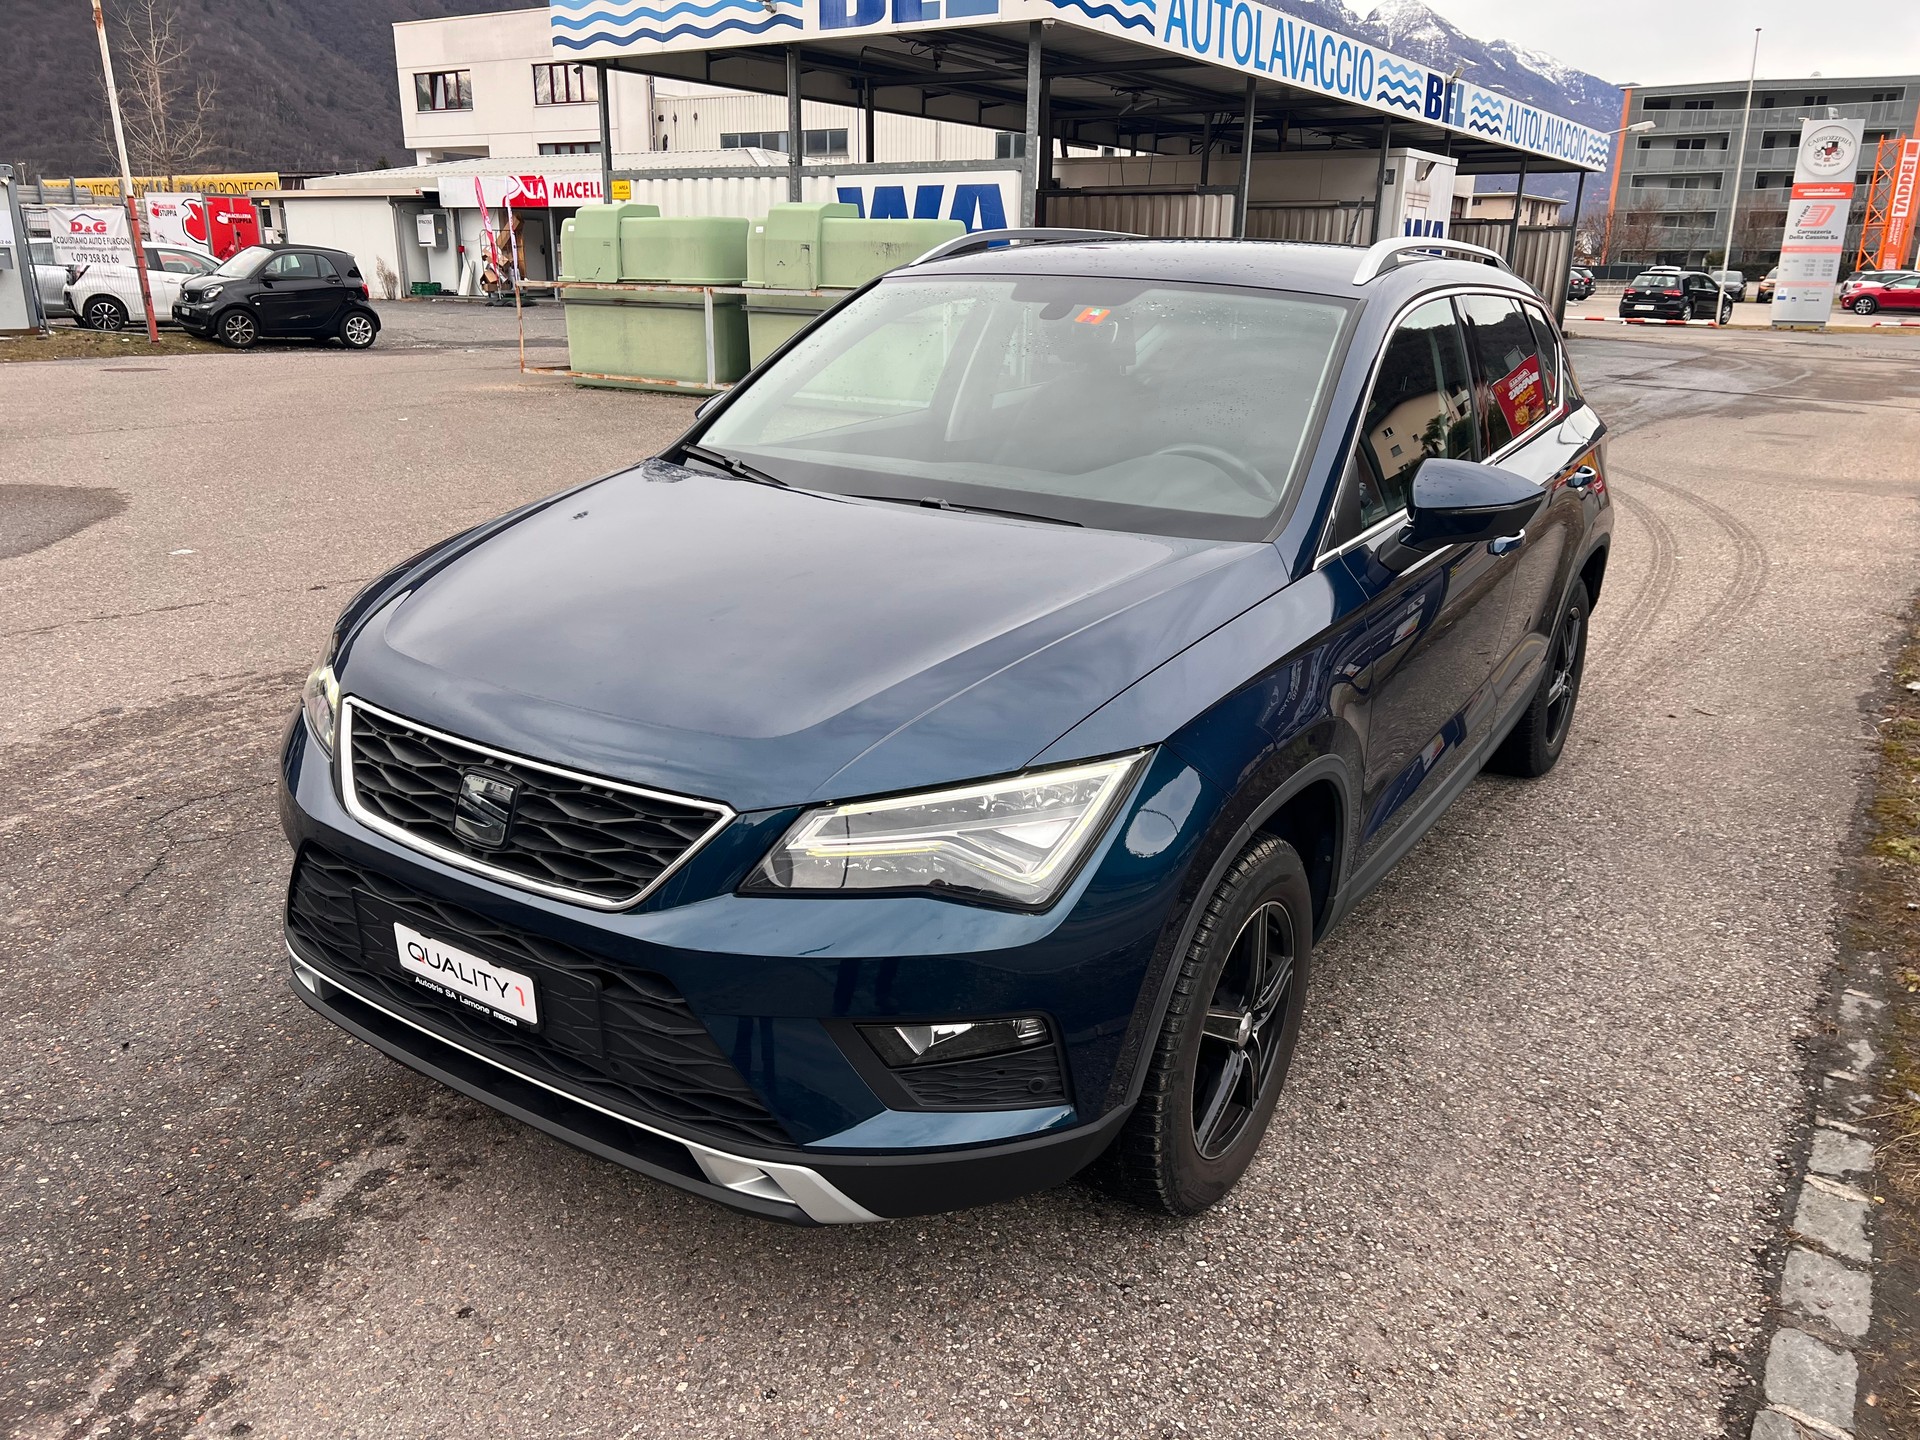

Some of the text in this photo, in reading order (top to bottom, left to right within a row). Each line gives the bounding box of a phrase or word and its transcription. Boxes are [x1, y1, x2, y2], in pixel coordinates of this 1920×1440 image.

[1424, 73, 1465, 128] BEL
[1894, 160, 1915, 214] TADDEI
[70, 221, 107, 233] D&G
[89, 237, 103, 246] AUTO
[76, 253, 120, 264] 079 358 82 66
[407, 941, 509, 998] QUALITY
[415, 976, 443, 994] Autotris
[444, 988, 457, 1000] SA
[459, 995, 490, 1014] Lamone
